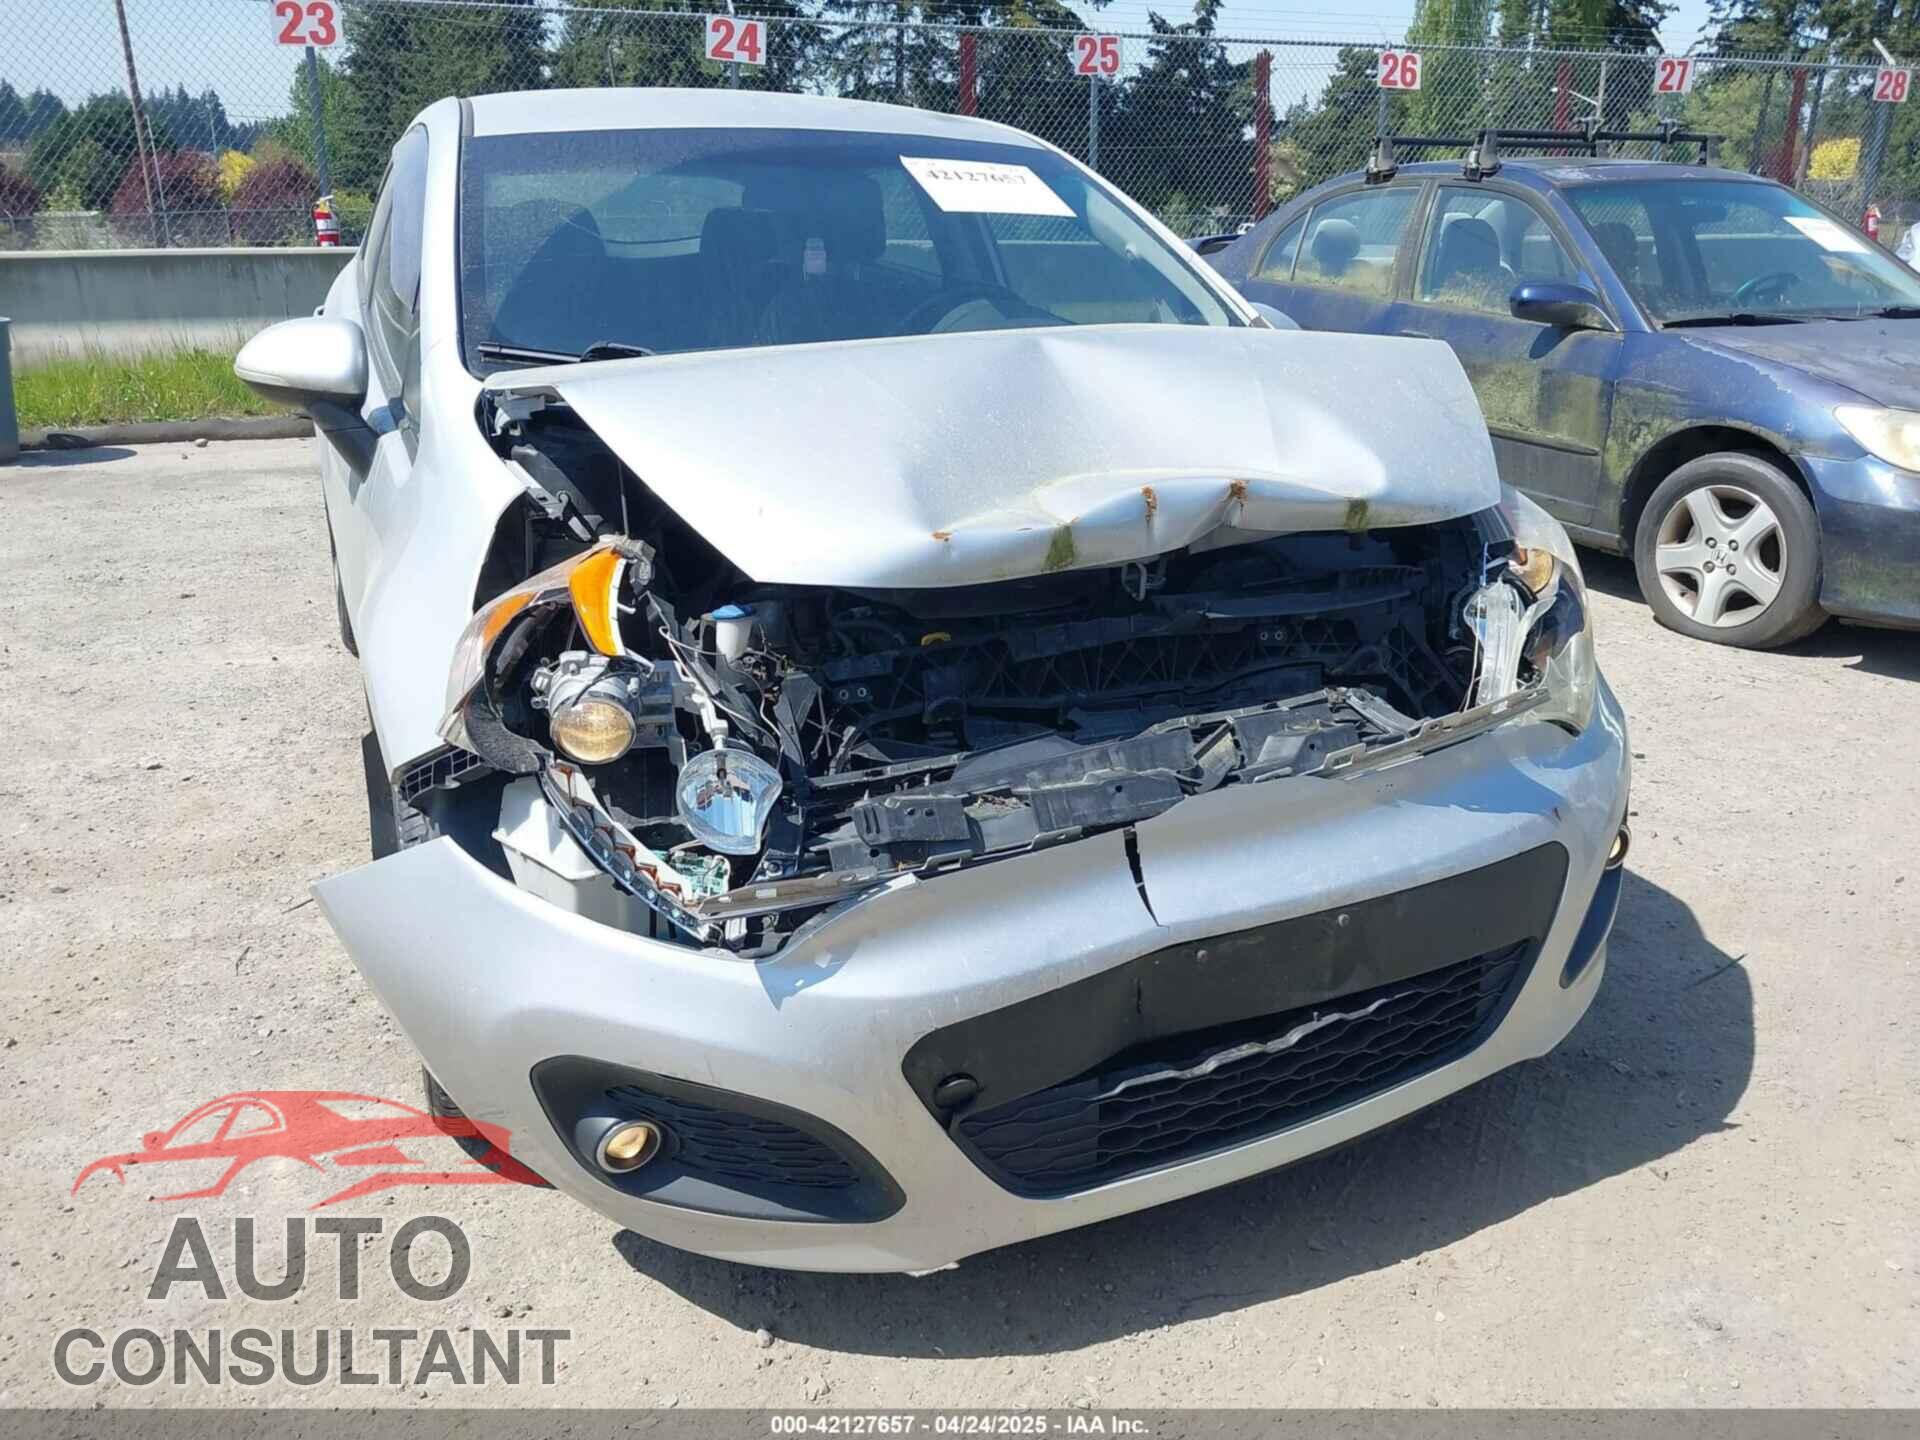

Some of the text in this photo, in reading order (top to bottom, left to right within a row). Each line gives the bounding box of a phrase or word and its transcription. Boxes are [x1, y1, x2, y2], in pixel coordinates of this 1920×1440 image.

[276, 1, 336, 45] 23
[710, 18, 761, 62] 24
[1078, 37, 1120, 73] 25
[1381, 53, 1417, 87] 26
[1658, 60, 1689, 91] 27
[1876, 70, 1908, 101] 28
[926, 169, 1028, 185] 42127657
